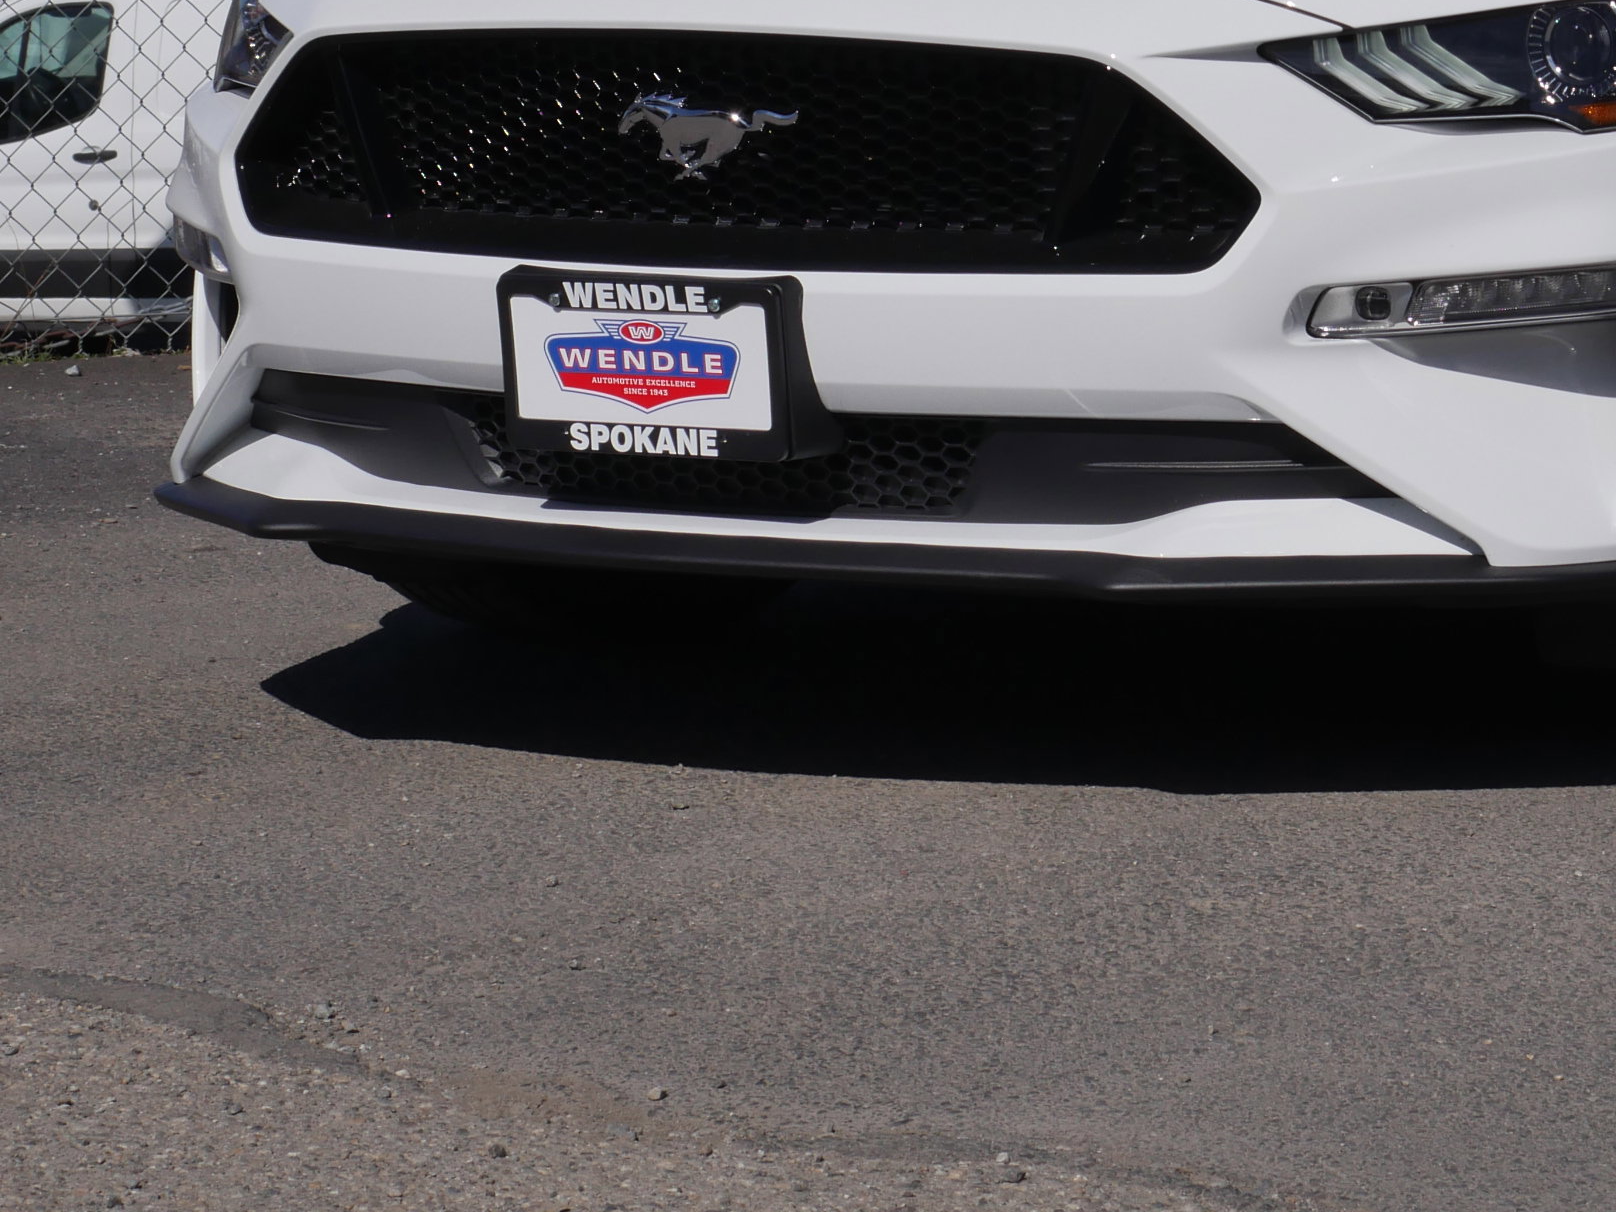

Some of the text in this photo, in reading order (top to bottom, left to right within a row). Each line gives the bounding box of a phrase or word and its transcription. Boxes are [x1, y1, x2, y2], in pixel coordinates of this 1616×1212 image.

[562, 281, 709, 313] WENDLE
[628, 325, 655, 340] W
[558, 347, 723, 374] WENDLE
[591, 376, 696, 389] AUTOMOTIVE EXCELLENCE
[623, 387, 669, 397] SINCE 1943
[569, 422, 720, 458] SPOKANE
